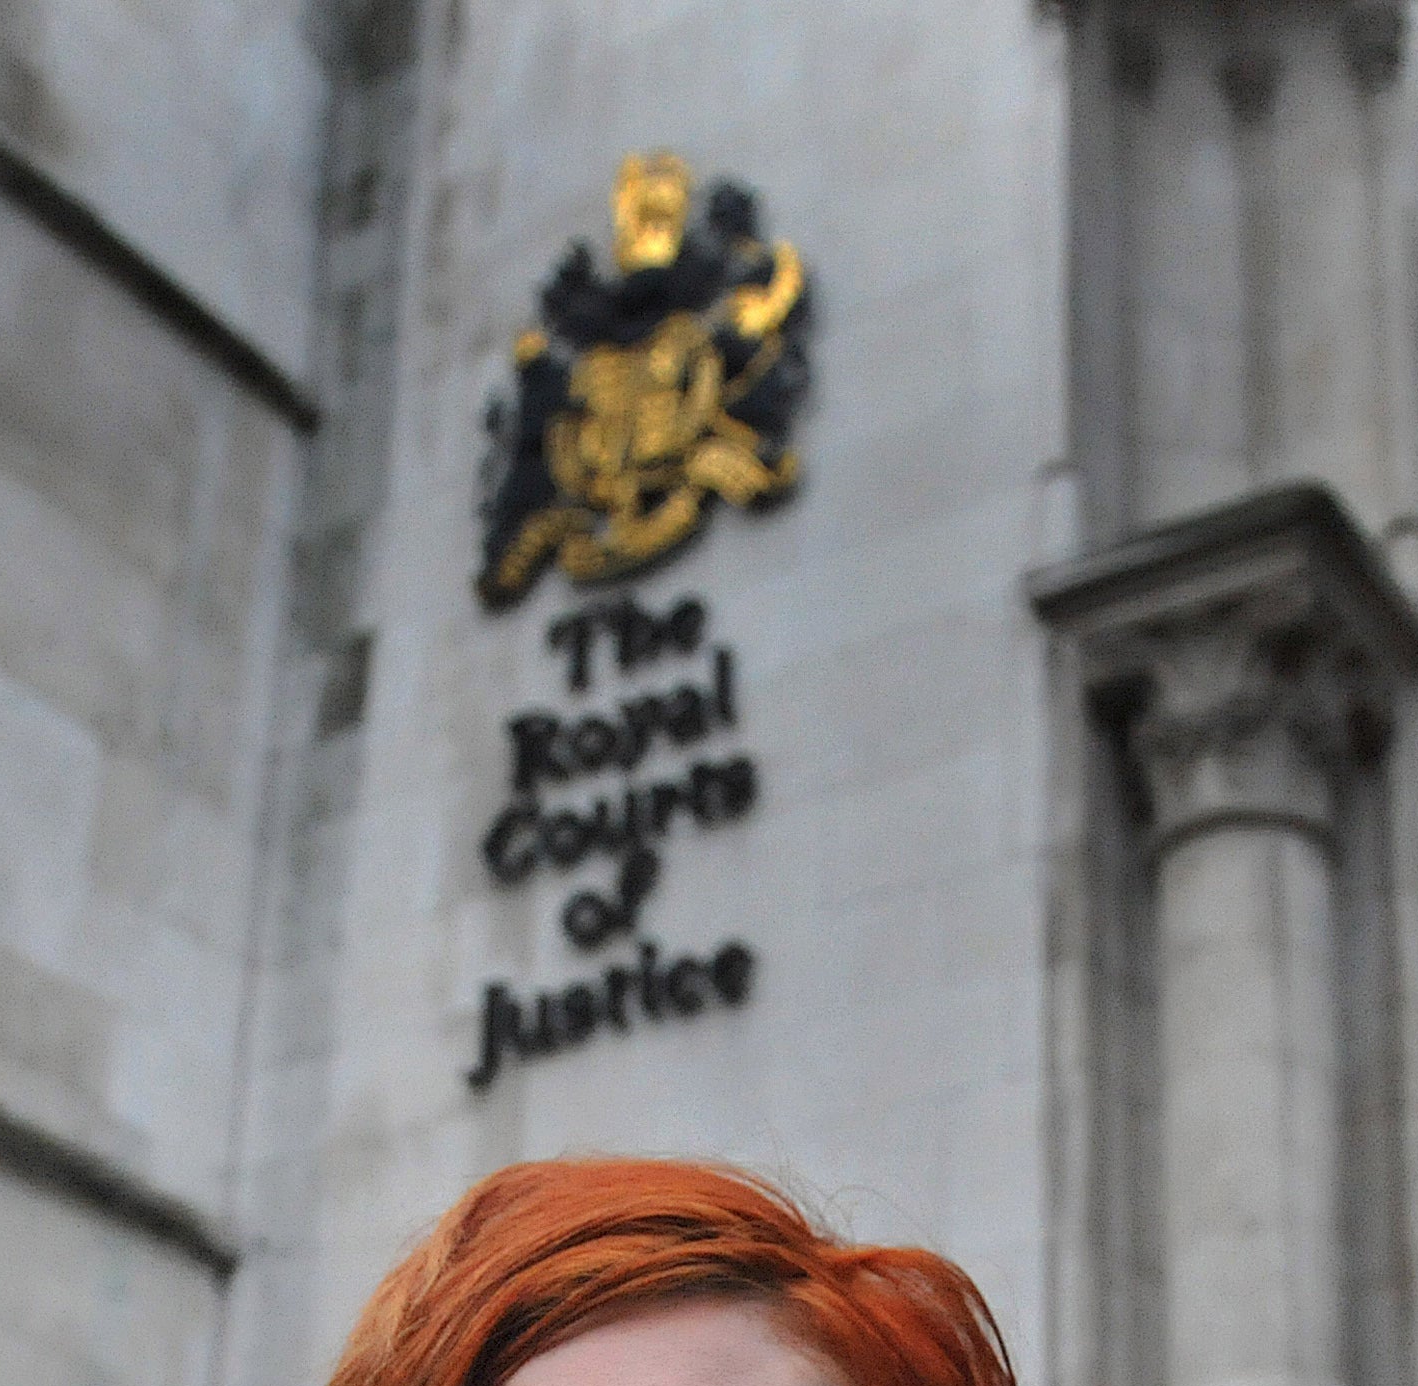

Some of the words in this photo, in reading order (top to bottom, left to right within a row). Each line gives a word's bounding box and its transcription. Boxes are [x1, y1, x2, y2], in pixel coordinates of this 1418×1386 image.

[548, 592, 708, 692] The
[505, 645, 737, 793] Royal
[486, 757, 757, 883] Courts
[562, 845, 660, 951] of
[466, 941, 755, 1090] Justice
